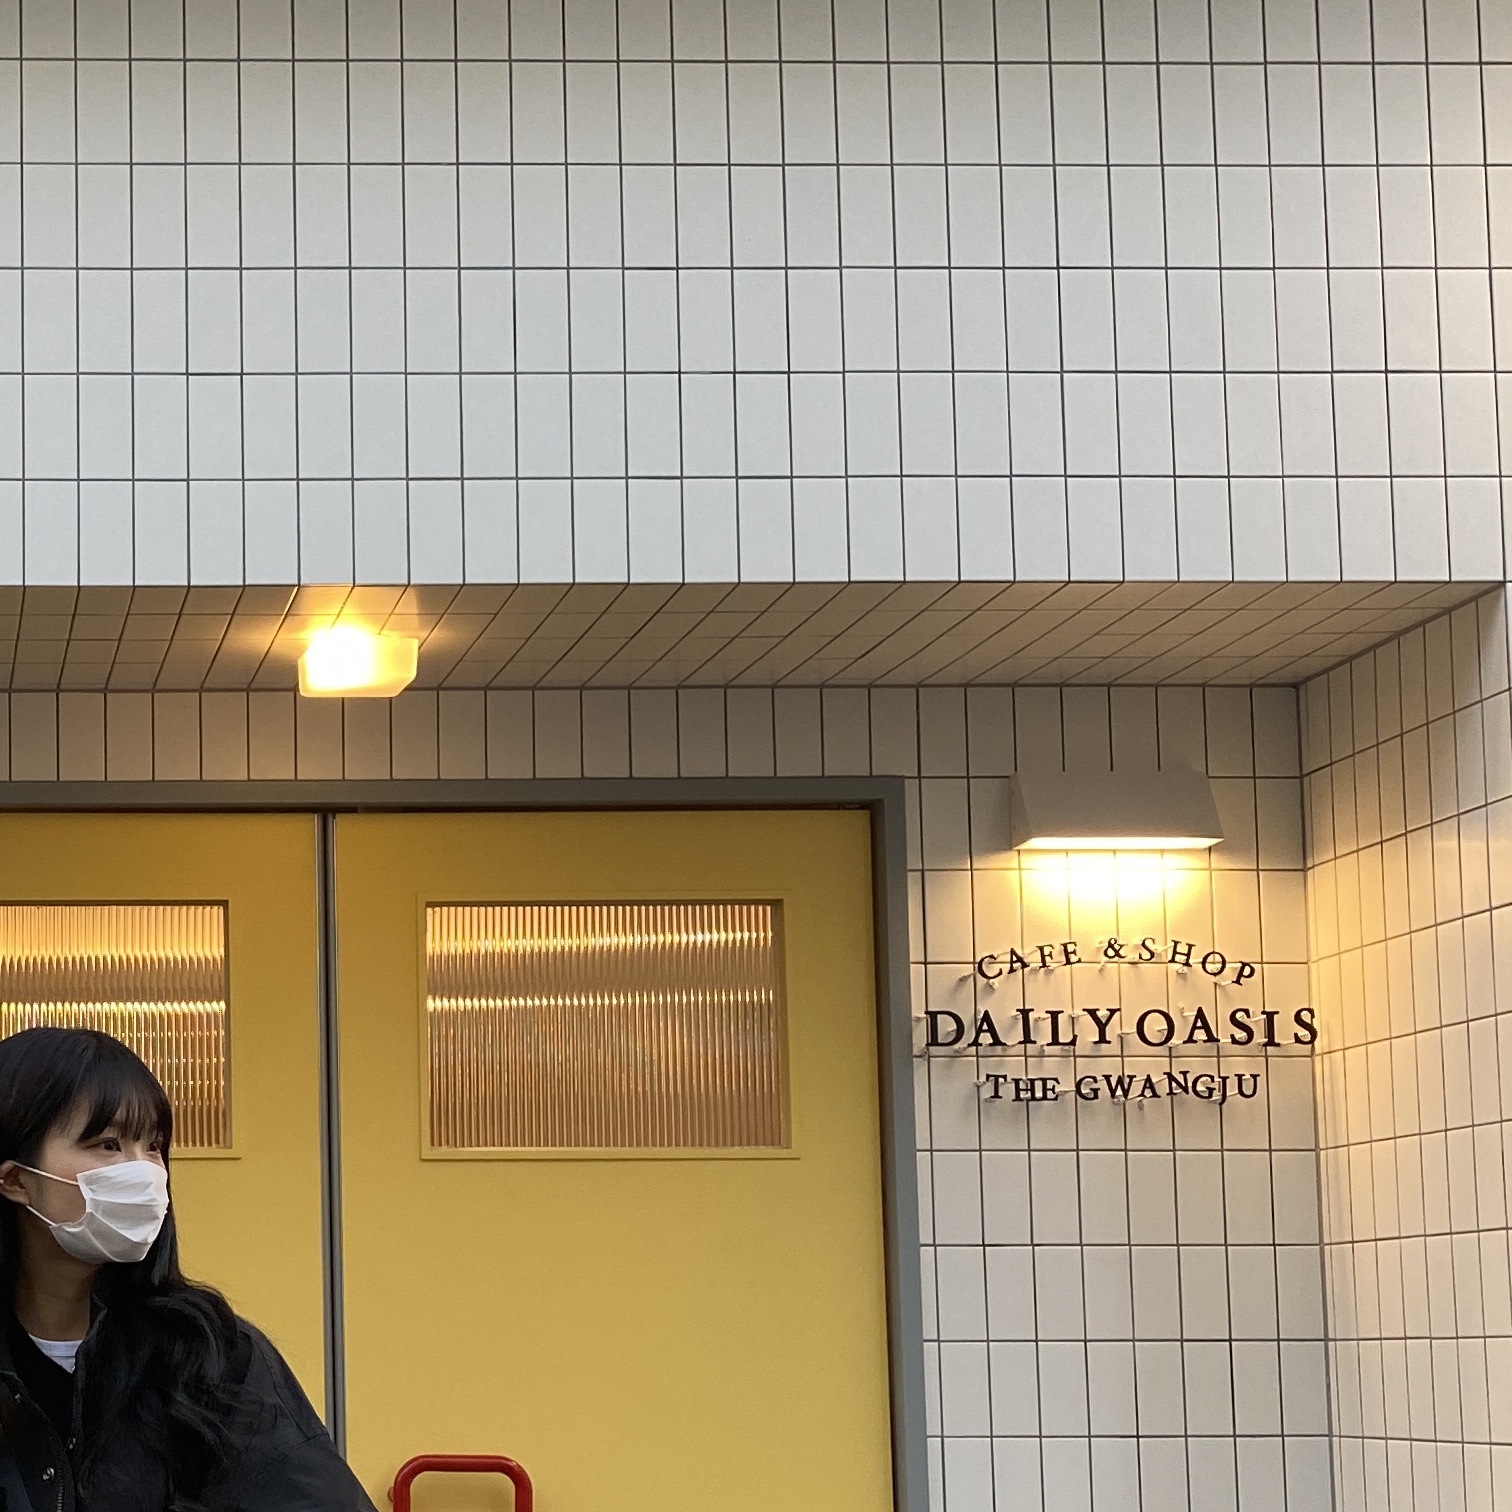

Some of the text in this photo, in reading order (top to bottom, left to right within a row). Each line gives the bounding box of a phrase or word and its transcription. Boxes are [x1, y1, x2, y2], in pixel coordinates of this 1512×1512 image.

[977, 937, 1256, 987] CAFE & SHOP
[925, 1006, 1319, 1047] DAILY OASIS
[985, 1070, 1261, 1106] THE GWANGJU
